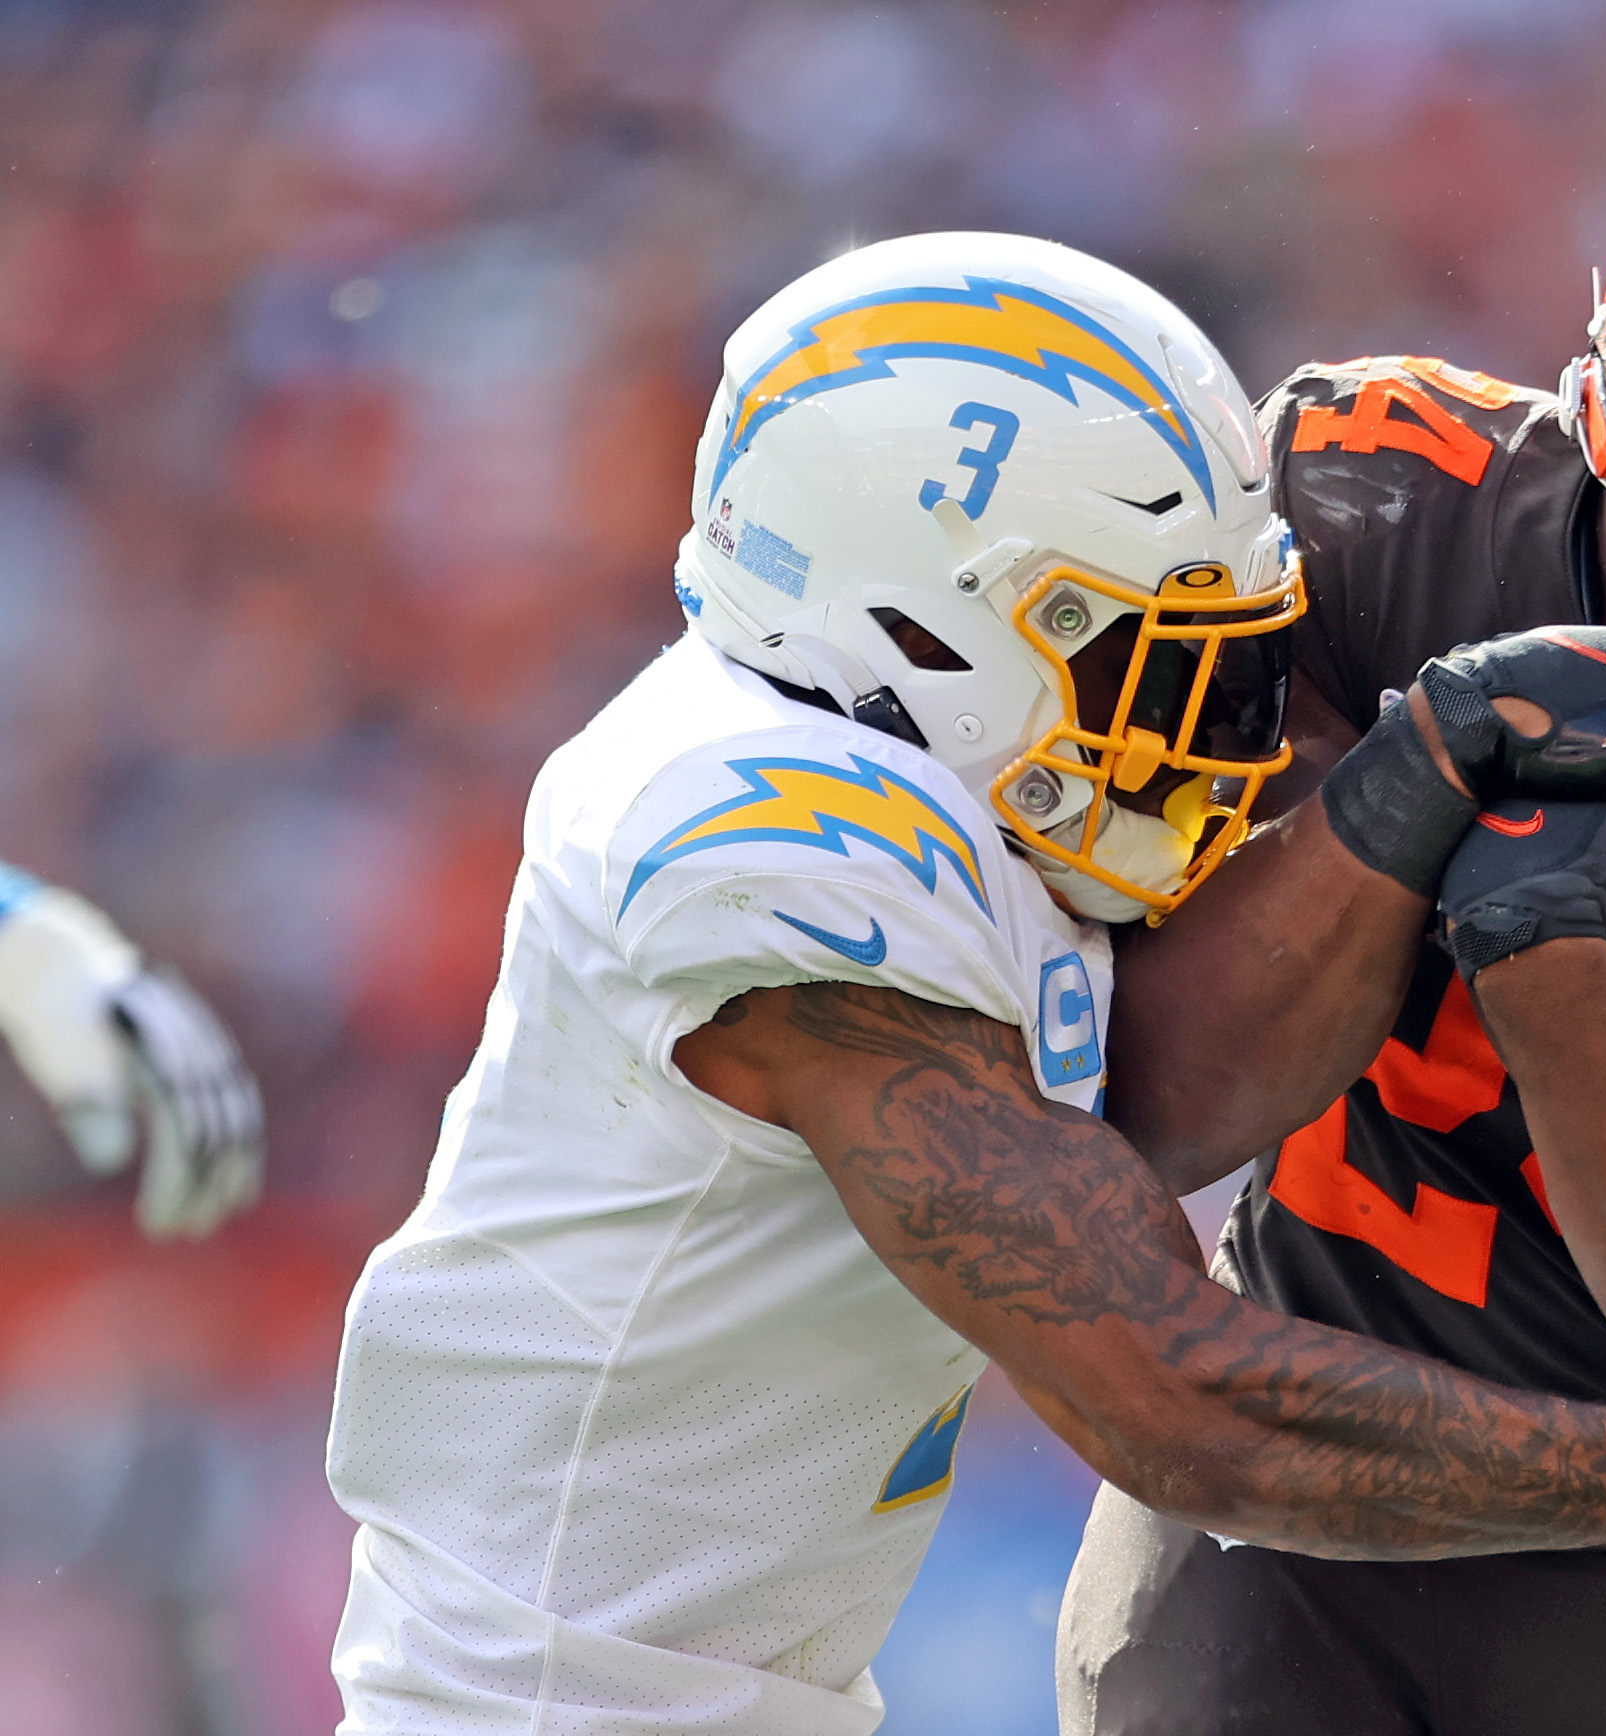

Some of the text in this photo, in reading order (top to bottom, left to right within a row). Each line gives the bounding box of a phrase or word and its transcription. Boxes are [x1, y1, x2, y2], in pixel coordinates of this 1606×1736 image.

[918, 401, 1020, 522] 3
[708, 522, 735, 555] CATCH
[1044, 963, 1093, 1054] C
